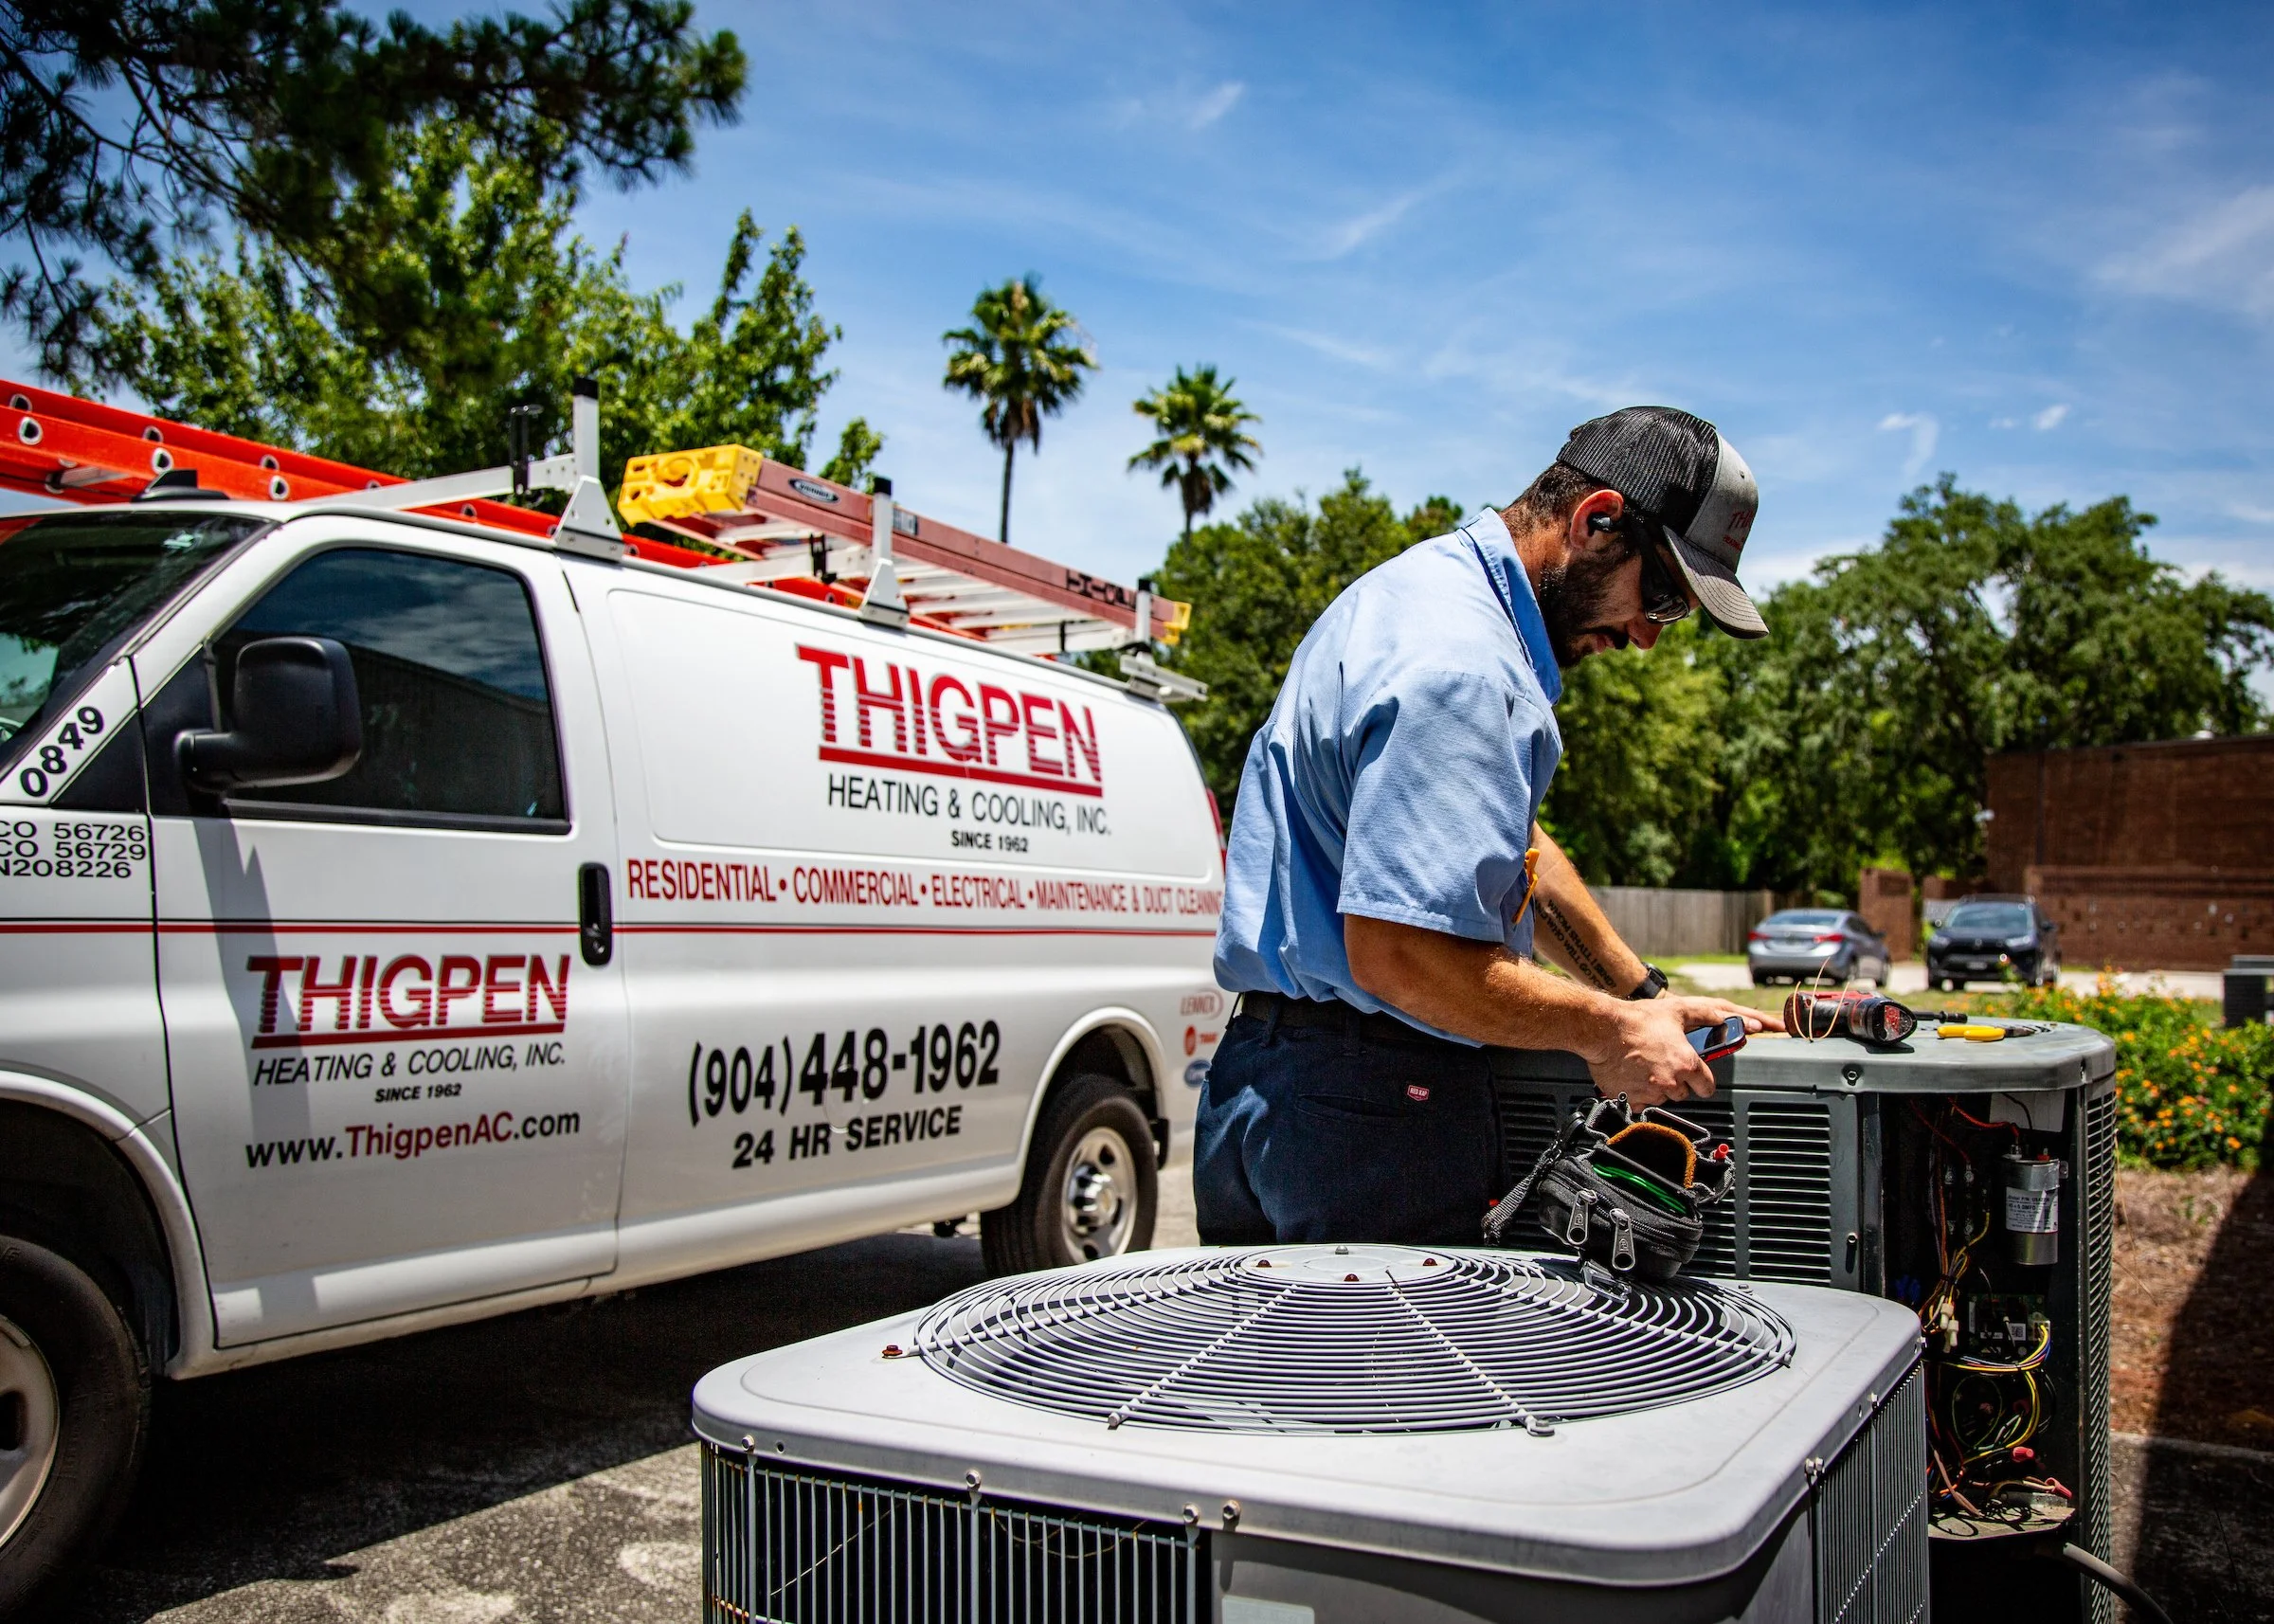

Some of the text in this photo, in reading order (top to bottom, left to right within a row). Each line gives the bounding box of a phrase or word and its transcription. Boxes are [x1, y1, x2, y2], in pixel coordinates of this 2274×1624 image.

[796, 643, 1103, 783] THIGPEN
[20, 706, 105, 798] 0849
[54, 822, 146, 842] 56726
[828, 773, 1111, 836] HEATING & COOLING, INC.
[55, 841, 147, 861] 56729
[950, 830, 1029, 854] SINCE 1962
[627, 858, 776, 903] RESIDENTIAL
[793, 866, 920, 908] COMMERCIAL
[931, 874, 1026, 911] ELECTRICAL
[1036, 879, 1128, 913] MAINTENANCE
[246, 954, 570, 1034] THIGPEN
[254, 1041, 566, 1087] HEATING & COOLING, INC.
[374, 1083, 461, 1103] SINCE 1962
[245, 1110, 581, 1168] www.ThigpenAC.com
[731, 1105, 963, 1170] 24 HR SERVICE
